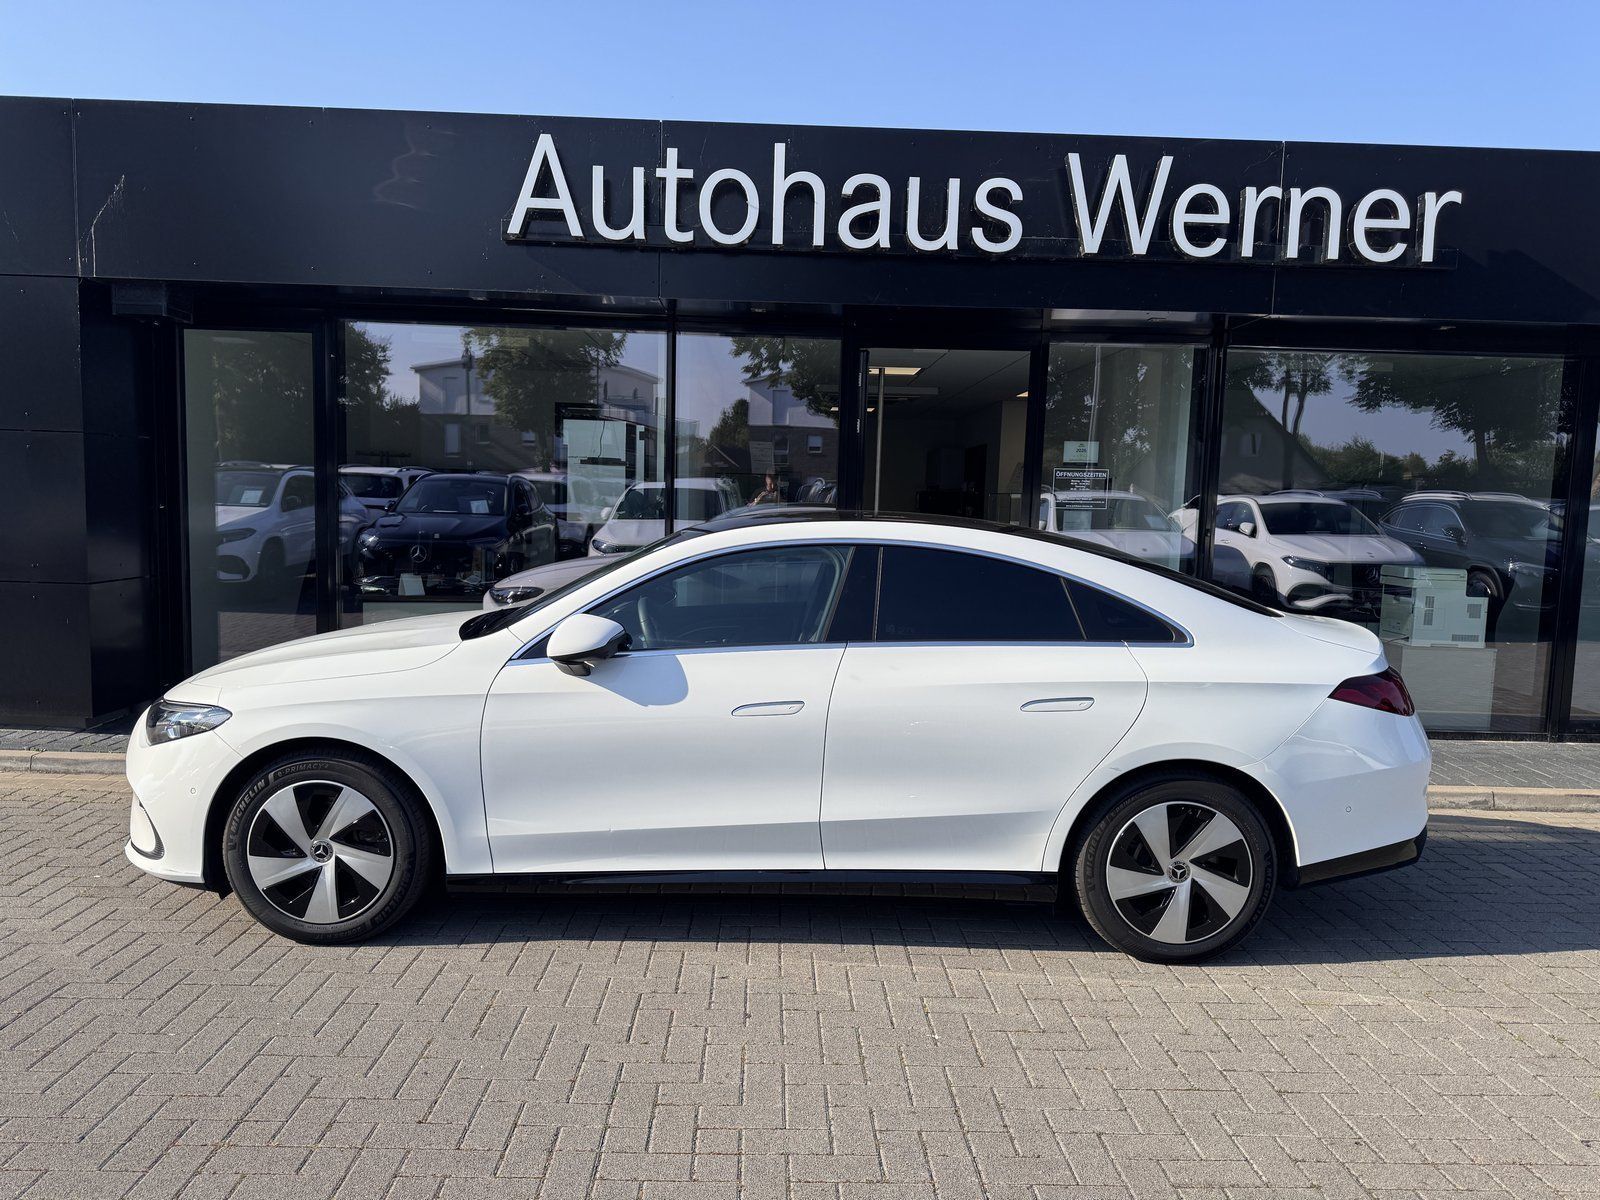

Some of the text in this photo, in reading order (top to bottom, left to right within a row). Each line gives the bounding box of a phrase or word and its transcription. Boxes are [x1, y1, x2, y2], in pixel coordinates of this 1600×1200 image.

[507, 133, 1463, 263] Autohaus Werner
[230, 778, 267, 832] MICHELIN
